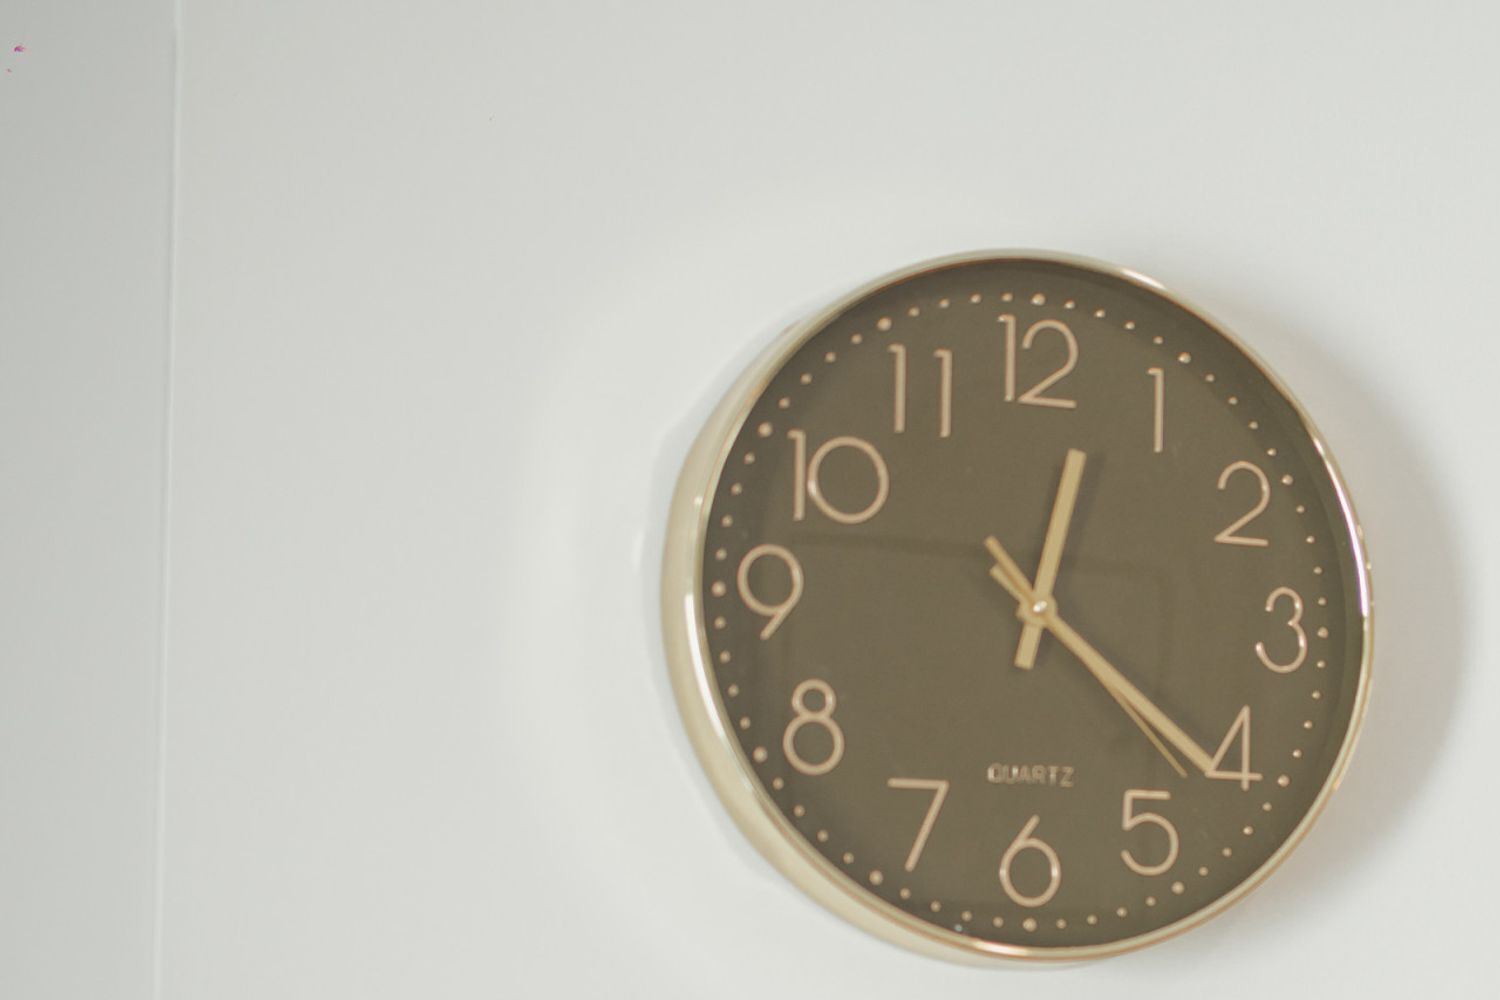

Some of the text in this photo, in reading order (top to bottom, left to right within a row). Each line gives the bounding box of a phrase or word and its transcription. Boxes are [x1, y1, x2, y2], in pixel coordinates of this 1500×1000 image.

[888, 343, 952, 438] 11
[997, 314, 1079, 408] 12
[1147, 367, 1164, 453] 1
[787, 429, 889, 524] 10
[1214, 460, 1271, 546] 2
[737, 543, 803, 640] 9
[1255, 587, 1308, 674] 3
[782, 678, 845, 775] 8
[1203, 705, 1263, 790] 4
[987, 762, 1075, 787] QUARTZ
[888, 777, 949, 871] 7
[1000, 815, 1061, 907] 6
[1120, 789, 1179, 876] 5
